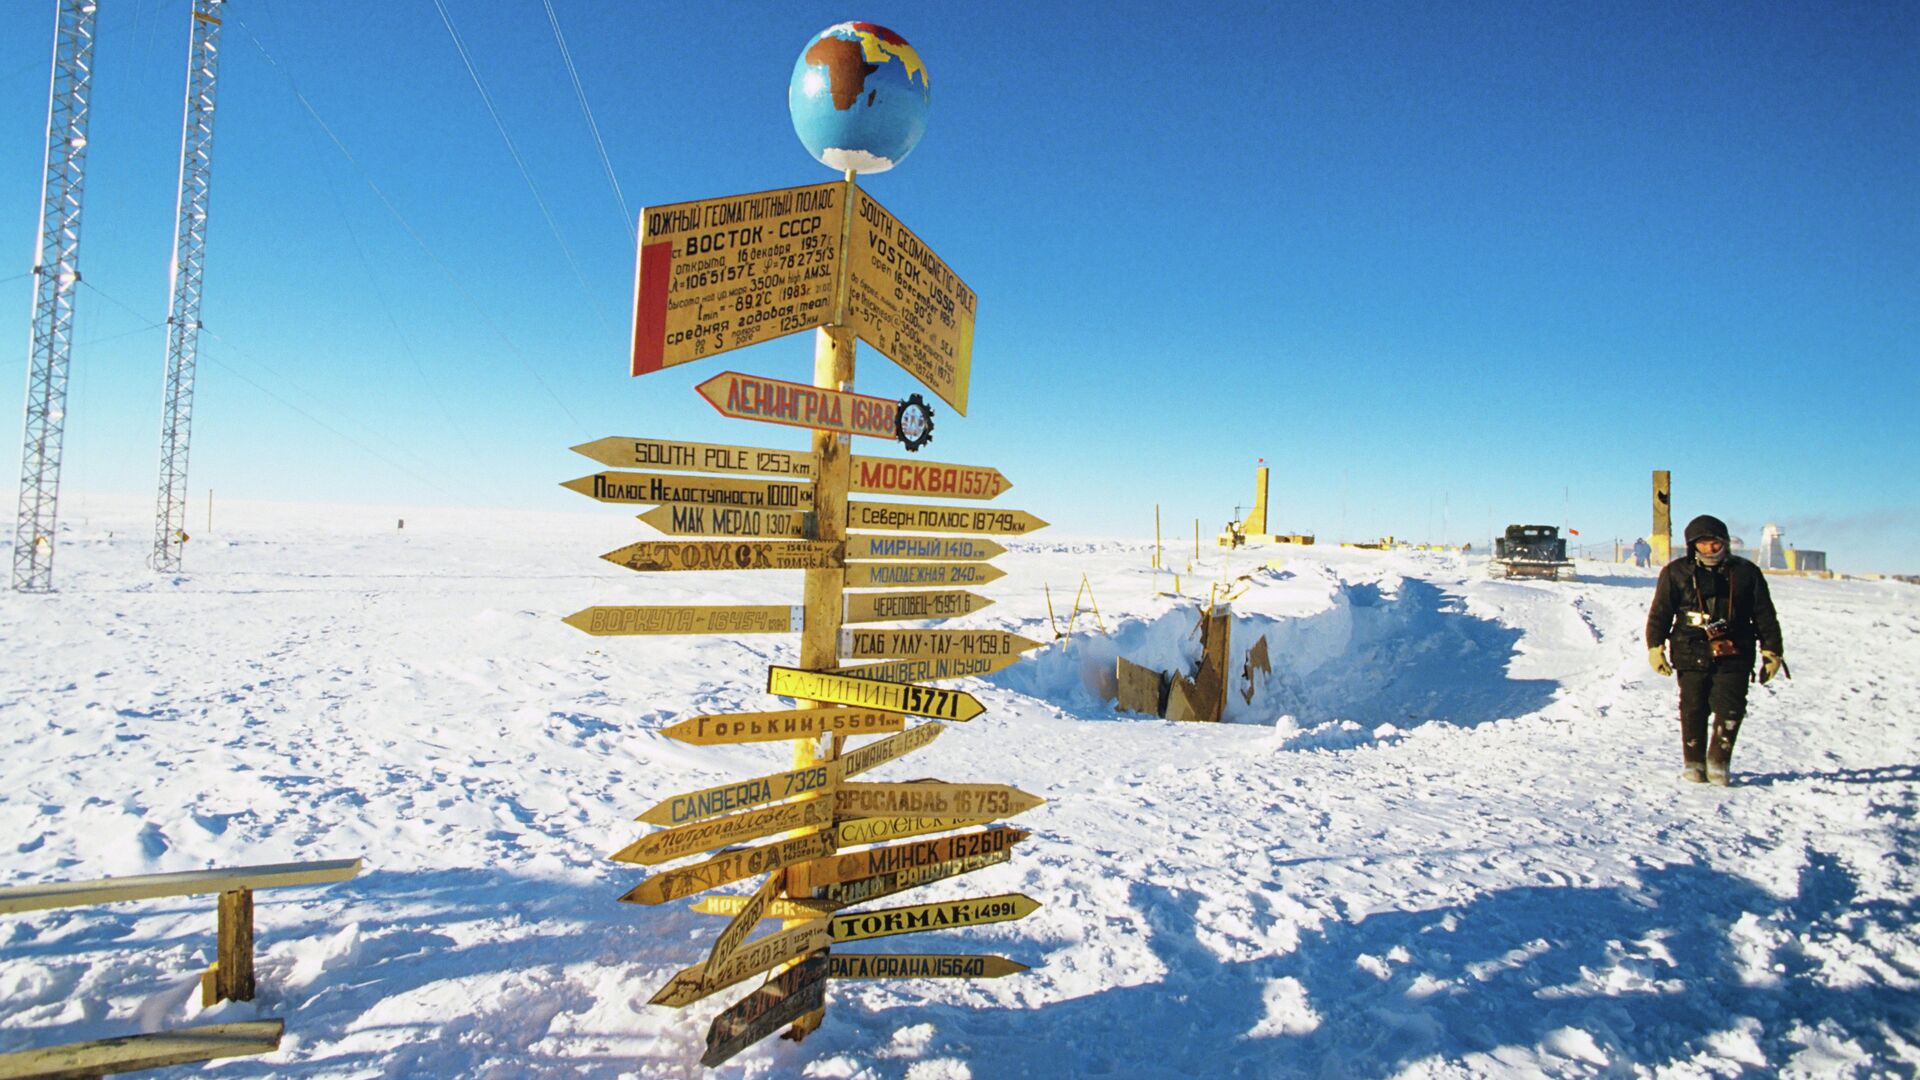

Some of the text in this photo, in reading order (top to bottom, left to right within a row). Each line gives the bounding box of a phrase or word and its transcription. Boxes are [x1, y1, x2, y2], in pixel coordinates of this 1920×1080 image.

[648, 187, 834, 236] ЮЖНЫЙ ГЕОМАГНИТНЫЙ ПОЛЮС
[685, 225, 762, 256] ВОСТОК
[779, 215, 821, 239] СССР
[738, 248, 748, 262] 16
[804, 262, 831, 280] AMSL
[860, 195, 973, 315] SOUTH GEOMAGNETIC POLE
[869, 227, 920, 287] VOSTOK
[929, 282, 954, 317] USSR
[727, 378, 894, 433] ЛЕНИНГРАД 16188
[635, 442, 695, 466] SOUTH
[705, 448, 748, 470] POLE
[860, 461, 1001, 496] МОСКВА 15575
[672, 505, 704, 534] МАК
[713, 508, 760, 536] МЕРДО
[653, 543, 772, 569] ТОМСК
[870, 538, 940, 557] МИРНЫЙ
[870, 566, 945, 583] МОЛОДЕЖНАЯ
[590, 607, 697, 633] ВОРКУТА
[775, 672, 959, 717] КАЛИНИН 15771
[845, 738, 895, 775] ДУШАНБЕ
[671, 766, 827, 822] CANBERRA 7326
[835, 790, 948, 813] ЯРОСЛАВЛЬ
[868, 841, 939, 875] МИНСК
[841, 904, 970, 937] ТОКМАК
